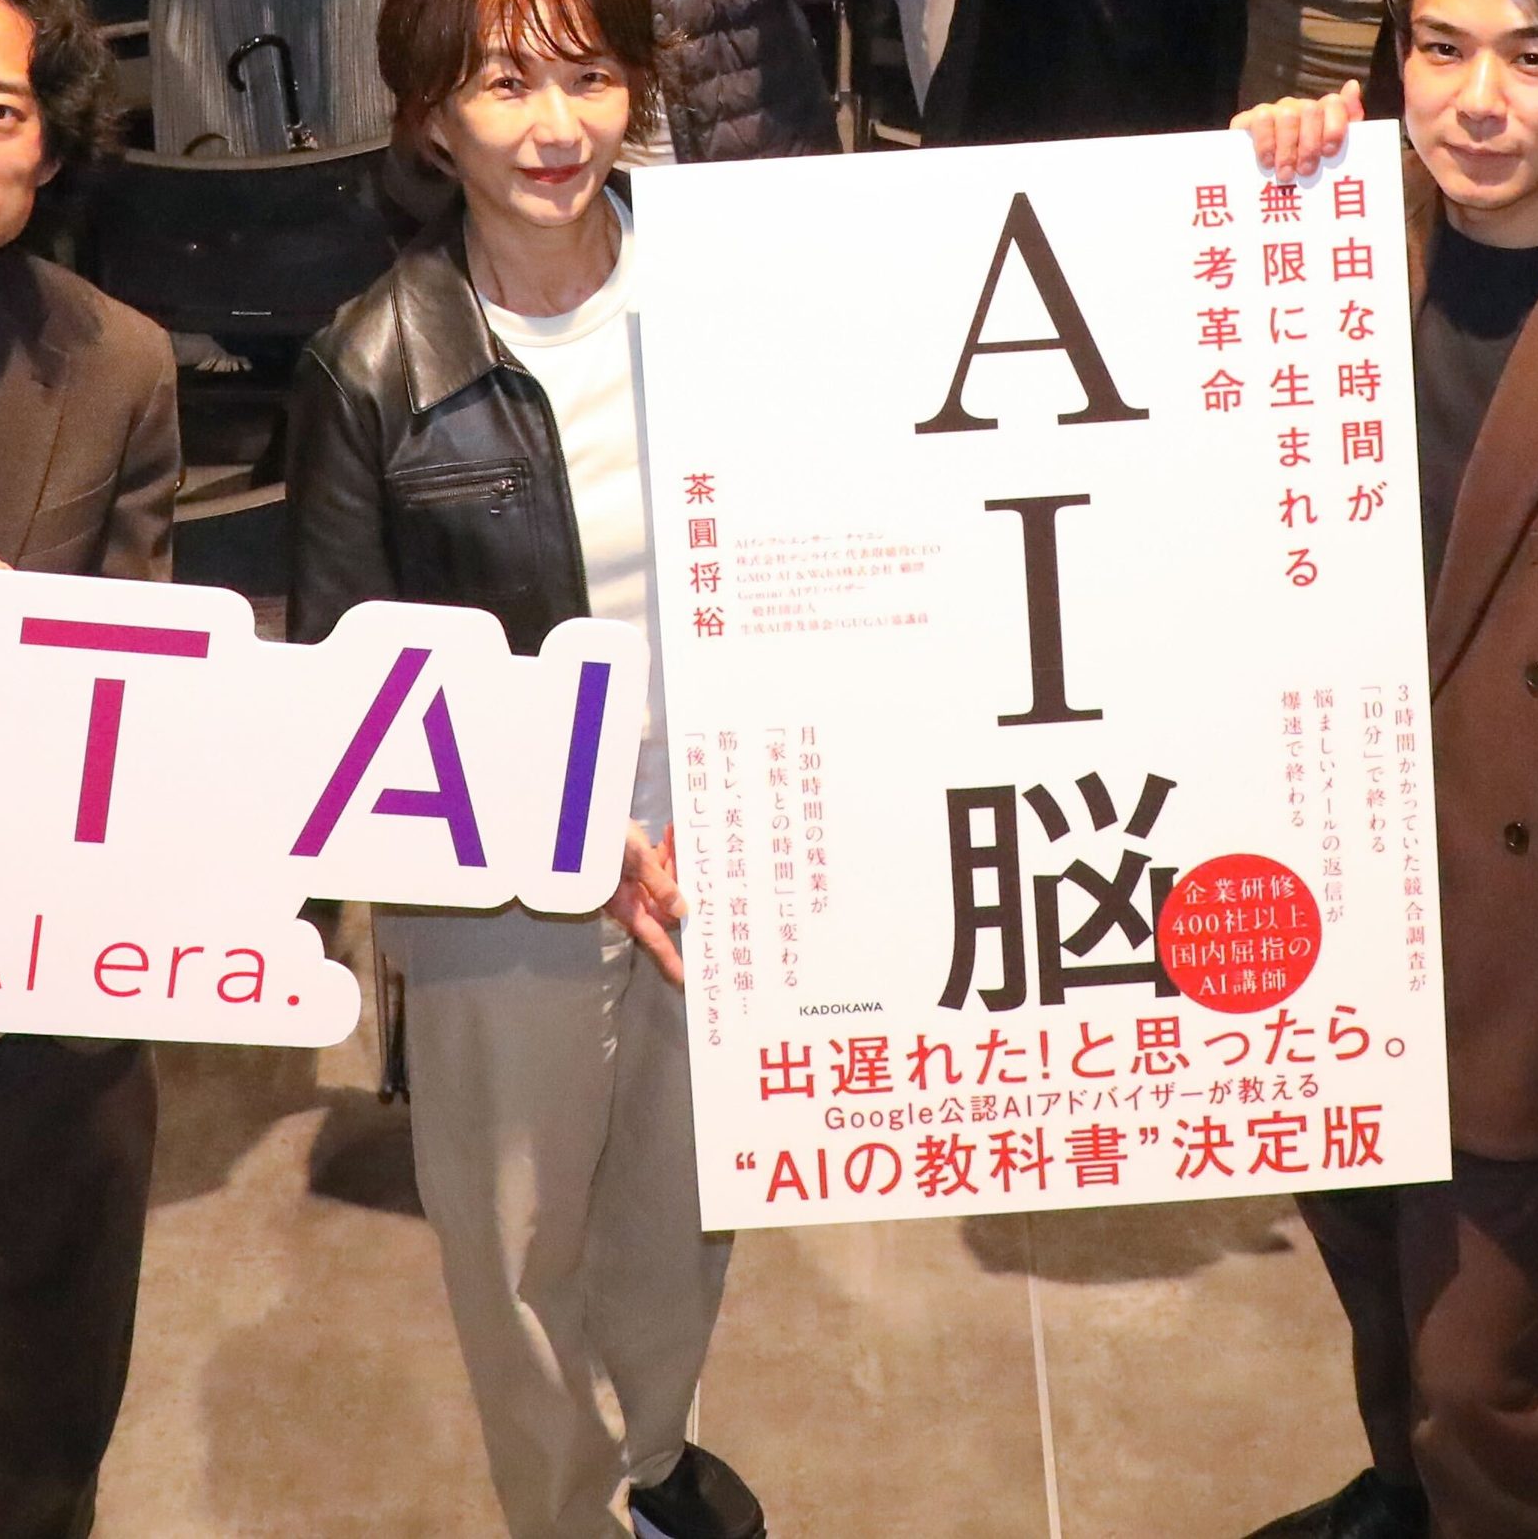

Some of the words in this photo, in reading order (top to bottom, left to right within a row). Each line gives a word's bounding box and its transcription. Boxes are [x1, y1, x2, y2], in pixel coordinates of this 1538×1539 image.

[1192, 184, 1245, 412] 思考革命
[1332, 175, 1386, 523] 自由な時間が
[1260, 183, 1319, 588] 無限に生まれる
[683, 473, 725, 637] 茶圓将裕
[914, 192, 1181, 1012] AI脳
[290, 647, 610, 873] AI
[1172, 904, 1309, 936] 400社以上
[1183, 874, 1296, 905] 企業研修
[92, 940, 306, 1008] era.
[1171, 936, 1311, 969] 国内屈指の
[1198, 967, 1287, 997] AI講師
[799, 1001, 884, 1017] KADOKAWA
[824, 1072, 1321, 1132] Google公認AIアドバイザーが教える
